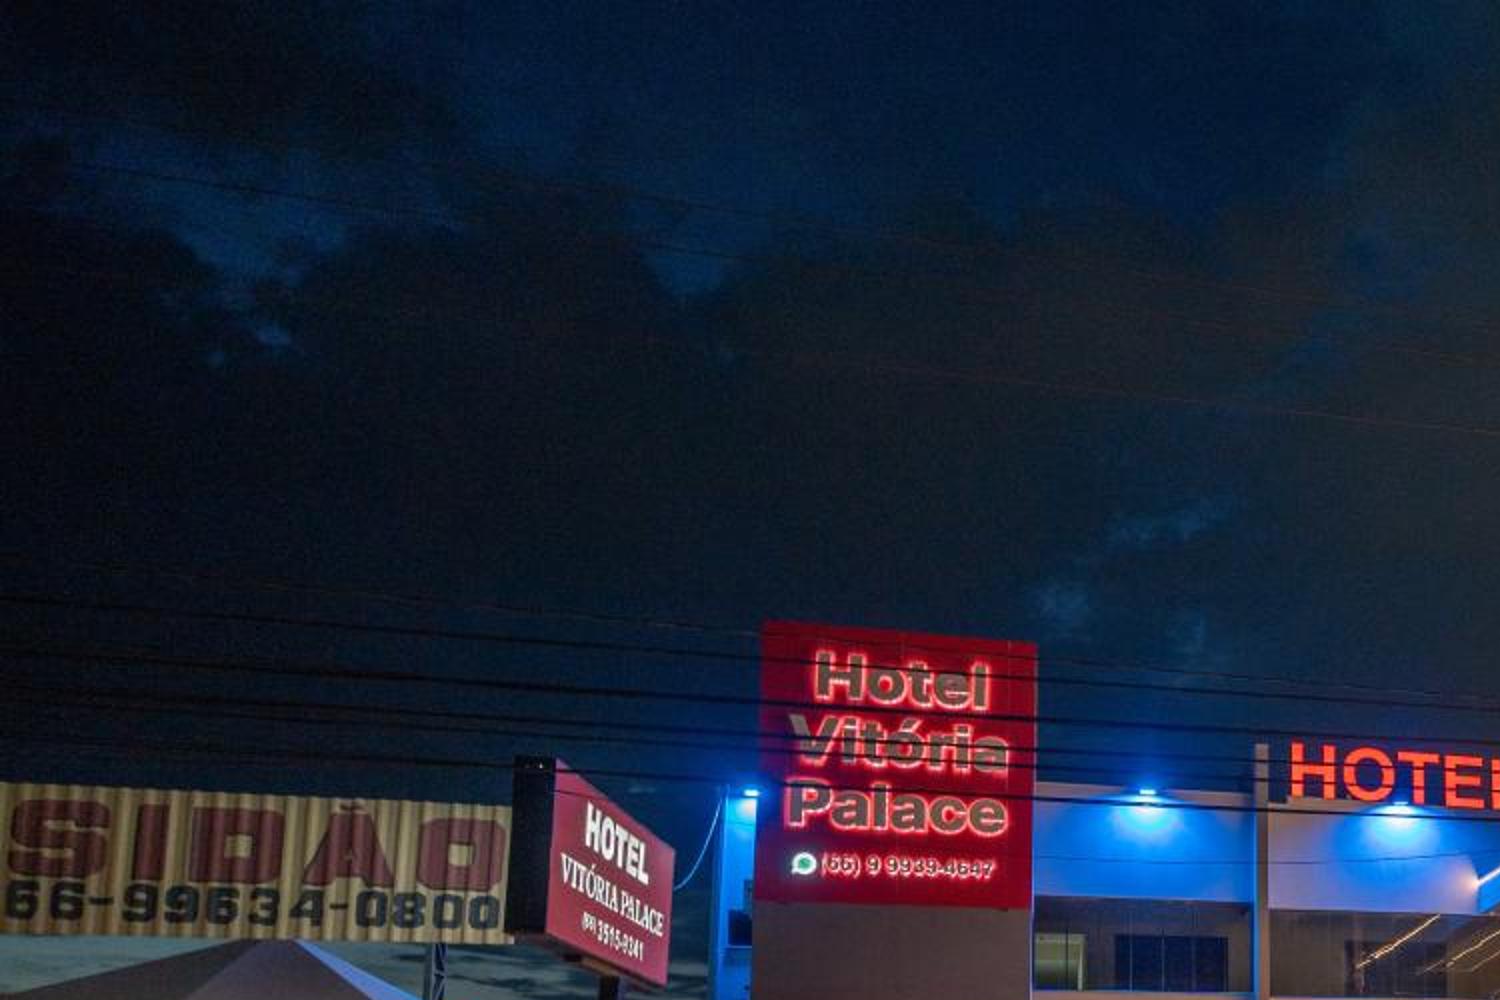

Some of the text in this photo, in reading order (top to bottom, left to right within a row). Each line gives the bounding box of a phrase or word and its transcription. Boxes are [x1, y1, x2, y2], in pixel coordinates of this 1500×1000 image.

[814, 649, 991, 711] Hotel
[788, 712, 1010, 773] Vitória
[784, 777, 1010, 838] Palace
[7, 799, 508, 892] SIDÃO
[585, 801, 649, 885] HOTEL
[865, 852, 882, 876] 9
[4, 879, 500, 930] 66-99634-0800
[560, 851, 665, 938] VITÓRIA PALACE
